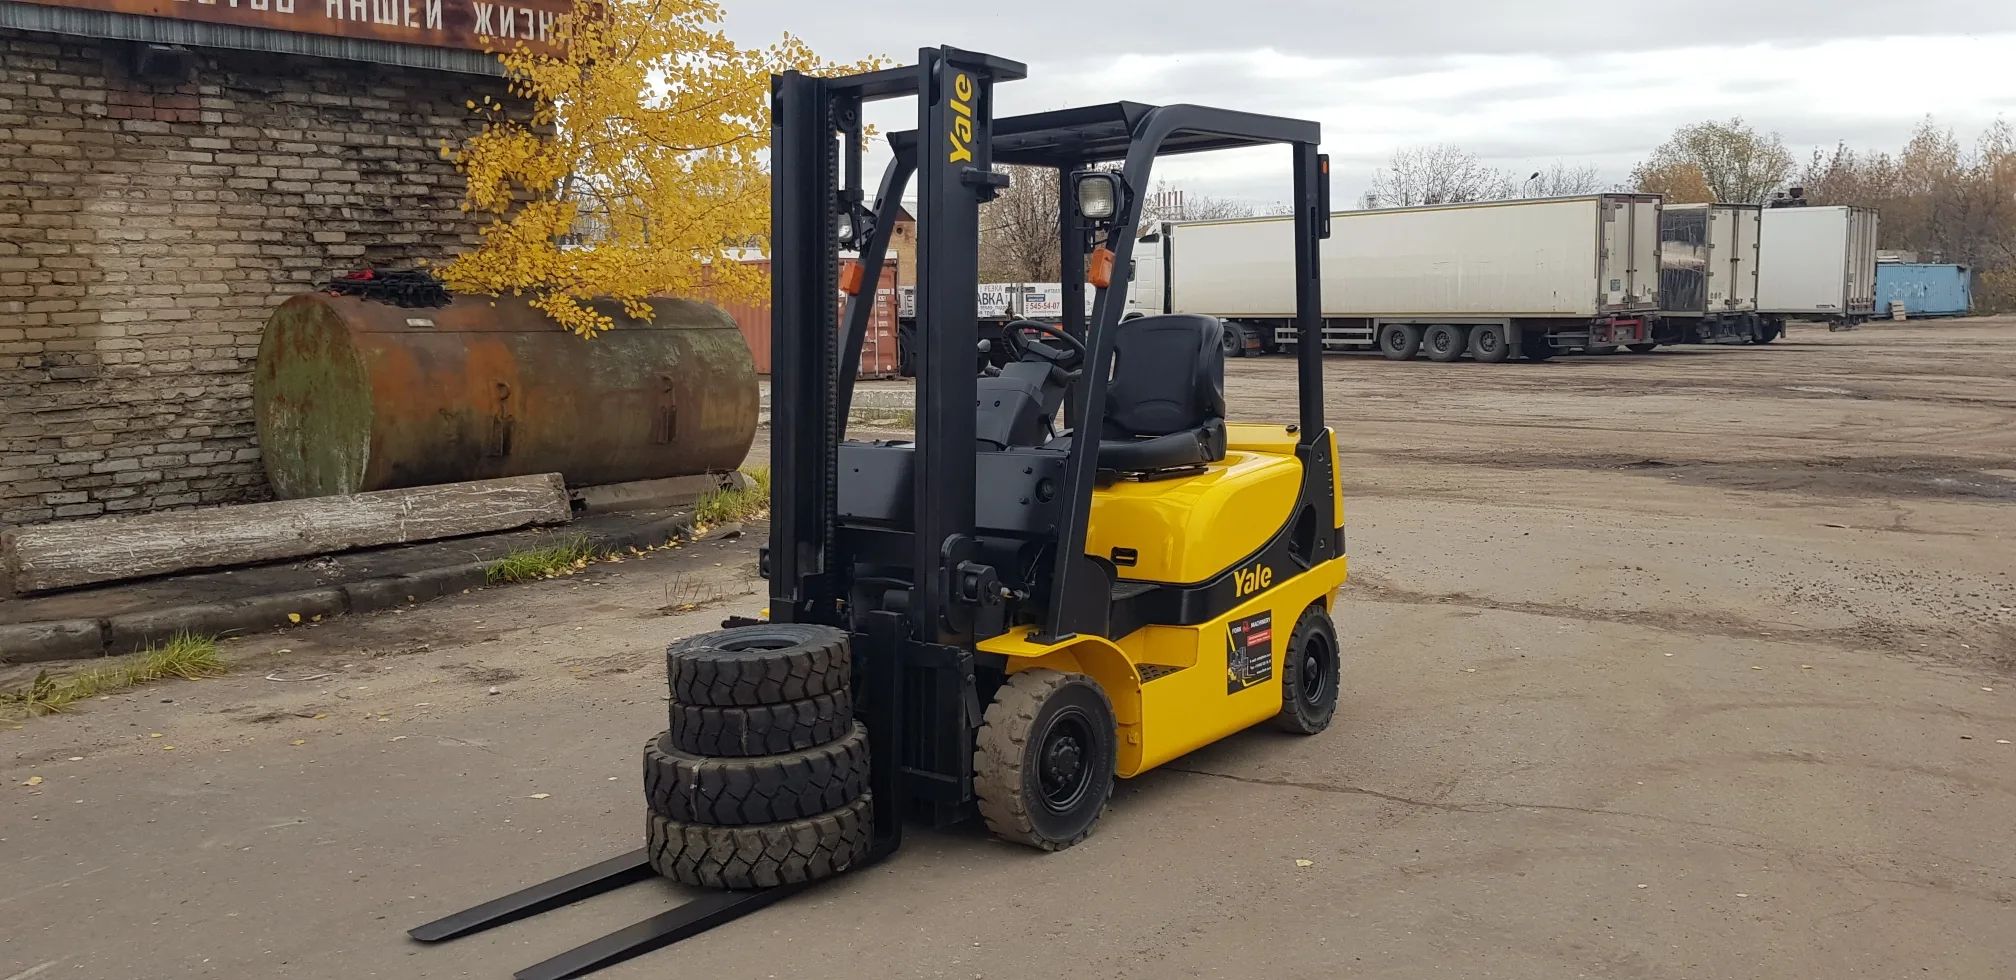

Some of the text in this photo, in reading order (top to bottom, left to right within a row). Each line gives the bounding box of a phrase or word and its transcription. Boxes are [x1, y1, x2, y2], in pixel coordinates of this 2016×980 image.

[949, 73, 972, 163] Yale
[1030, 302, 1060, 310] 545-54-07
[1234, 564, 1272, 598] Yale
